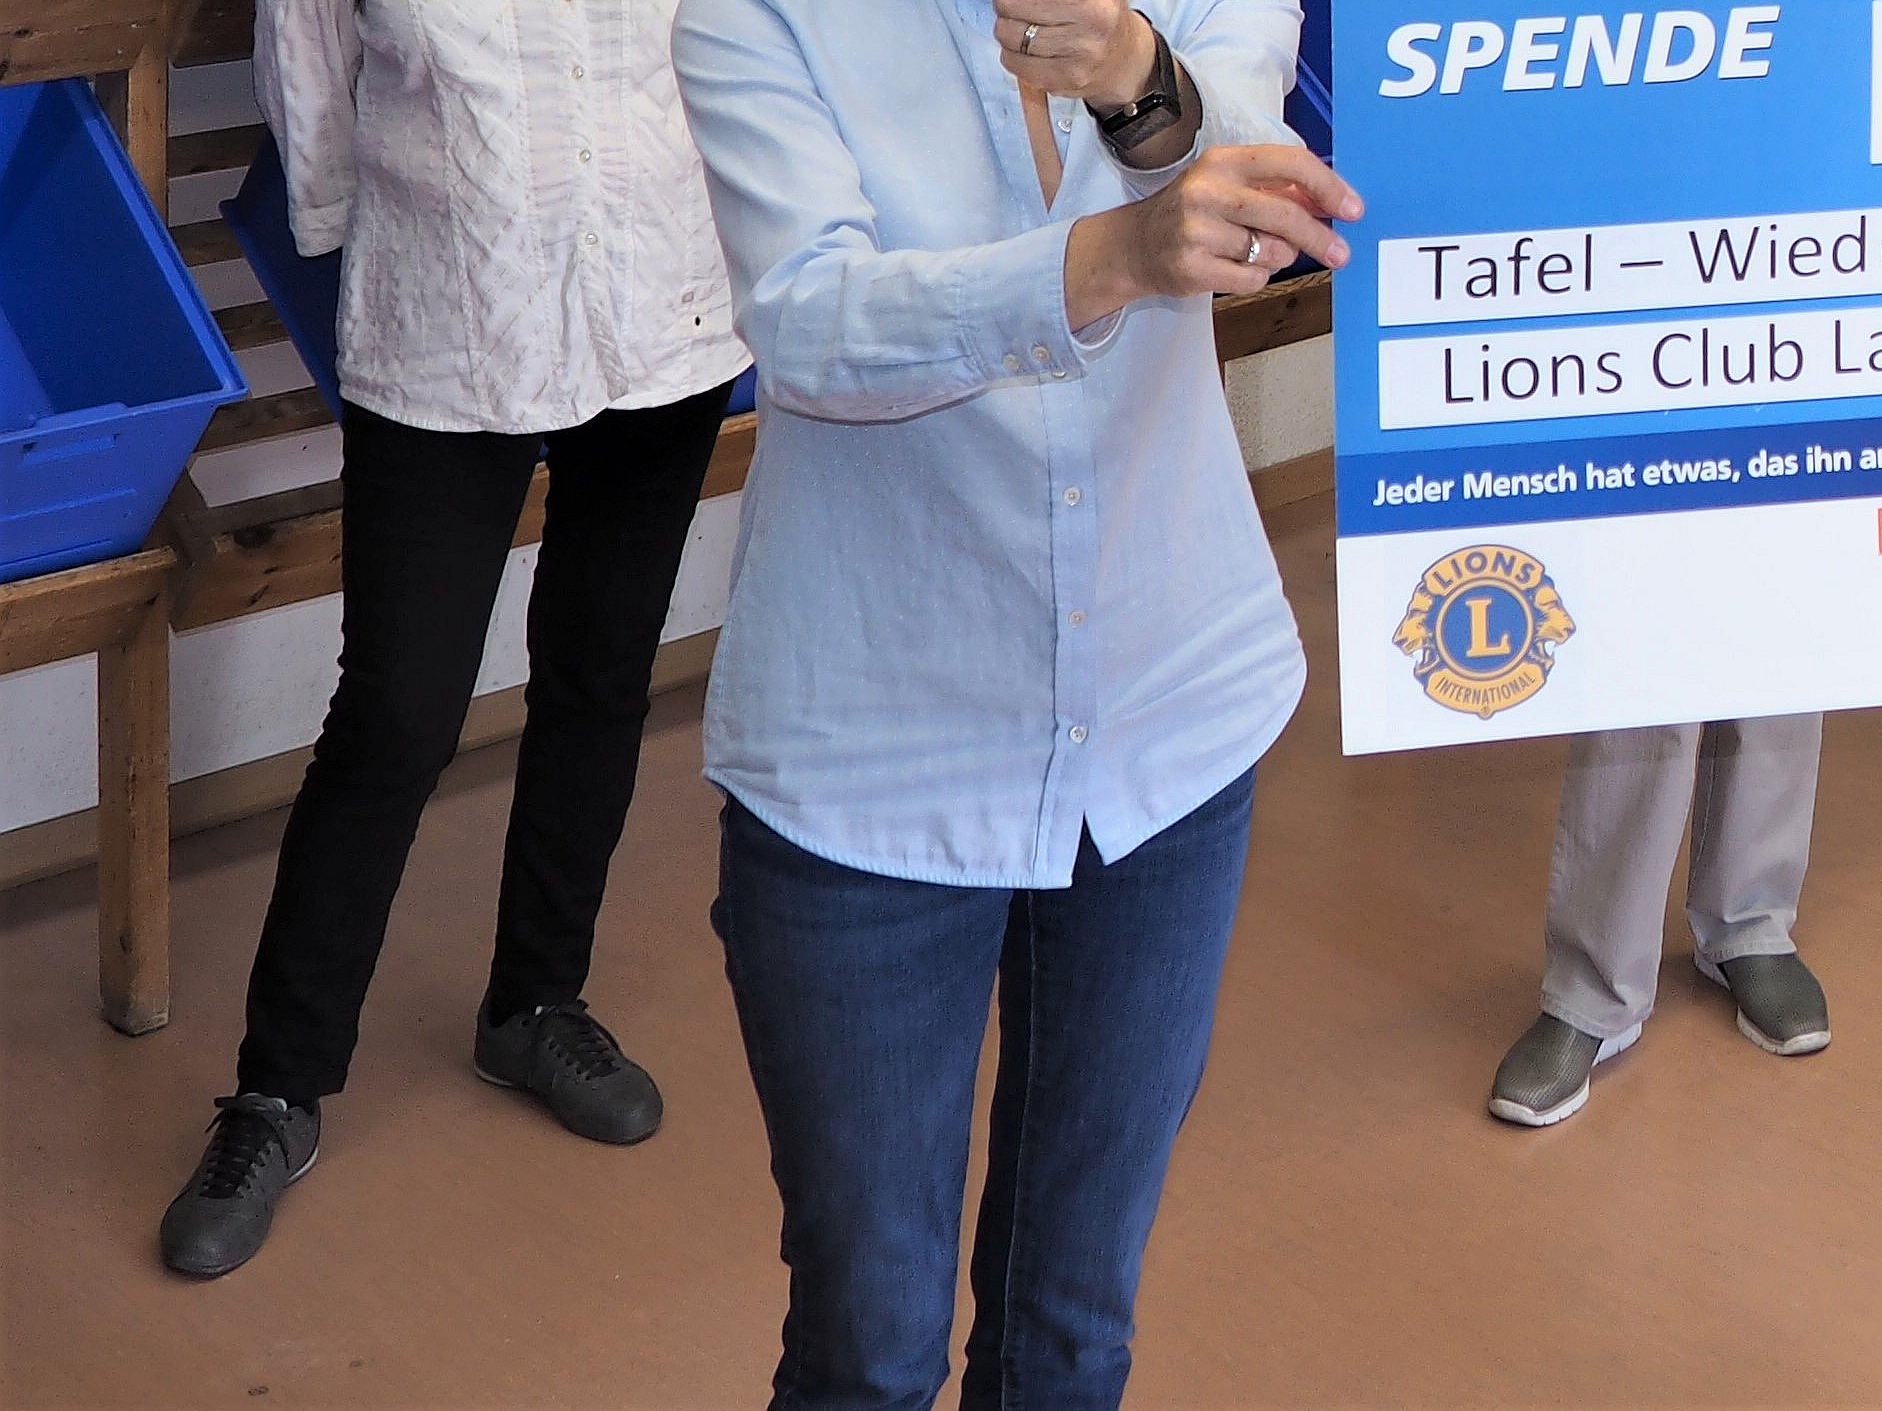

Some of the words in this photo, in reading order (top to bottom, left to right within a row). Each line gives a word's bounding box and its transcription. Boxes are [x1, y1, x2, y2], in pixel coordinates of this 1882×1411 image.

[1379, 4, 1780, 97] SPENDE
[1417, 233, 1593, 301] Tafel
[1444, 343, 1623, 404] Lions
[1652, 323, 1804, 389] Club
[1372, 474, 1455, 507] Jeder
[1463, 464, 1578, 500] Mensch
[1585, 461, 1636, 490] hat
[1642, 457, 1741, 486] etwas,
[1747, 448, 1799, 478] das
[1805, 445, 1852, 474] ihn
[1432, 551, 1536, 589] LIONS
[1465, 597, 1511, 658] L
[1435, 672, 1536, 706] INTERNATIONAL
